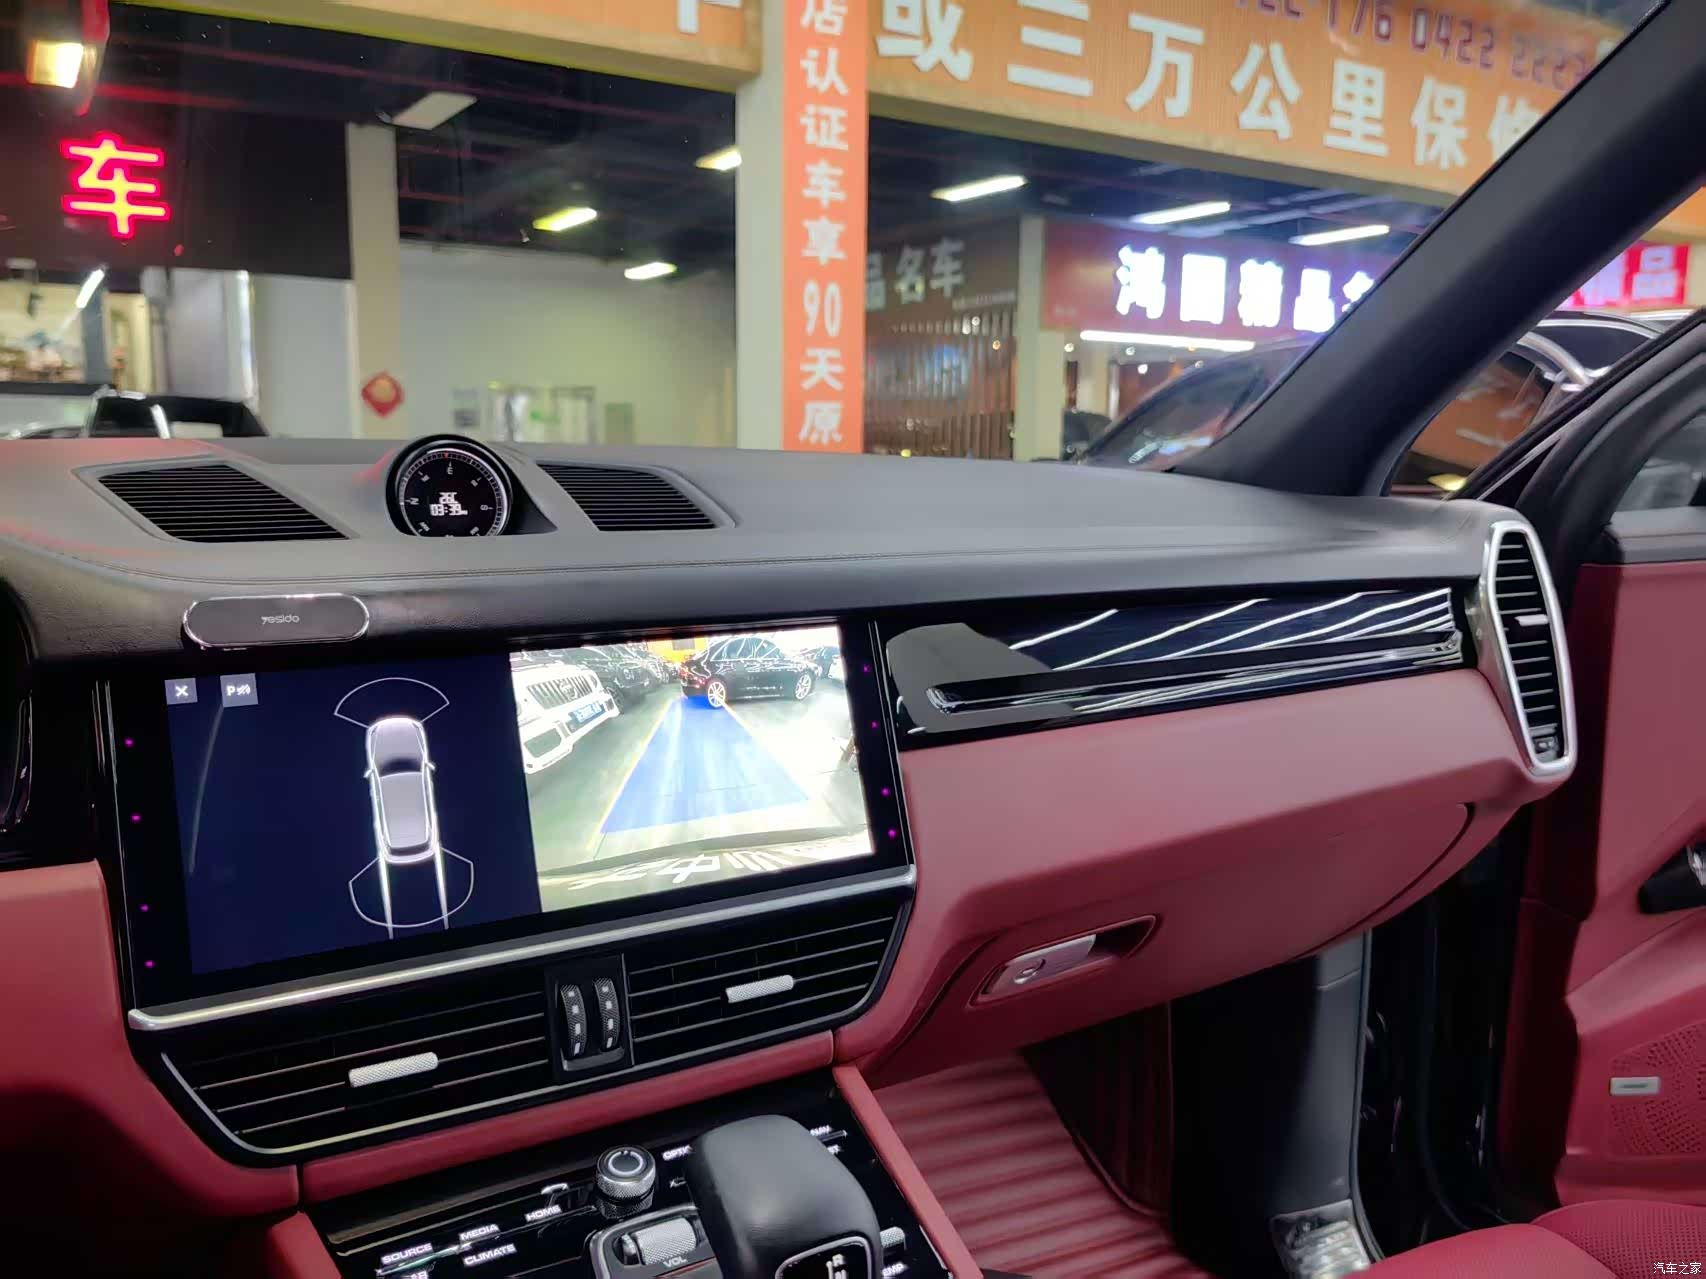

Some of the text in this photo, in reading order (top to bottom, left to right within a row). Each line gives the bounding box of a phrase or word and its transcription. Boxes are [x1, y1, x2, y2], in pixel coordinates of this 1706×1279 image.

[1408, 7, 1496, 71] 0422
[60, 132, 170, 238] 车
[261, 614, 301, 625] yesido
[525, 1204, 562, 1222] HOME
[459, 1223, 500, 1242] MEDIA
[381, 1242, 434, 1265] SOURCE
[463, 1243, 517, 1267] CLIMATE
[662, 1255, 688, 1269] VOL
